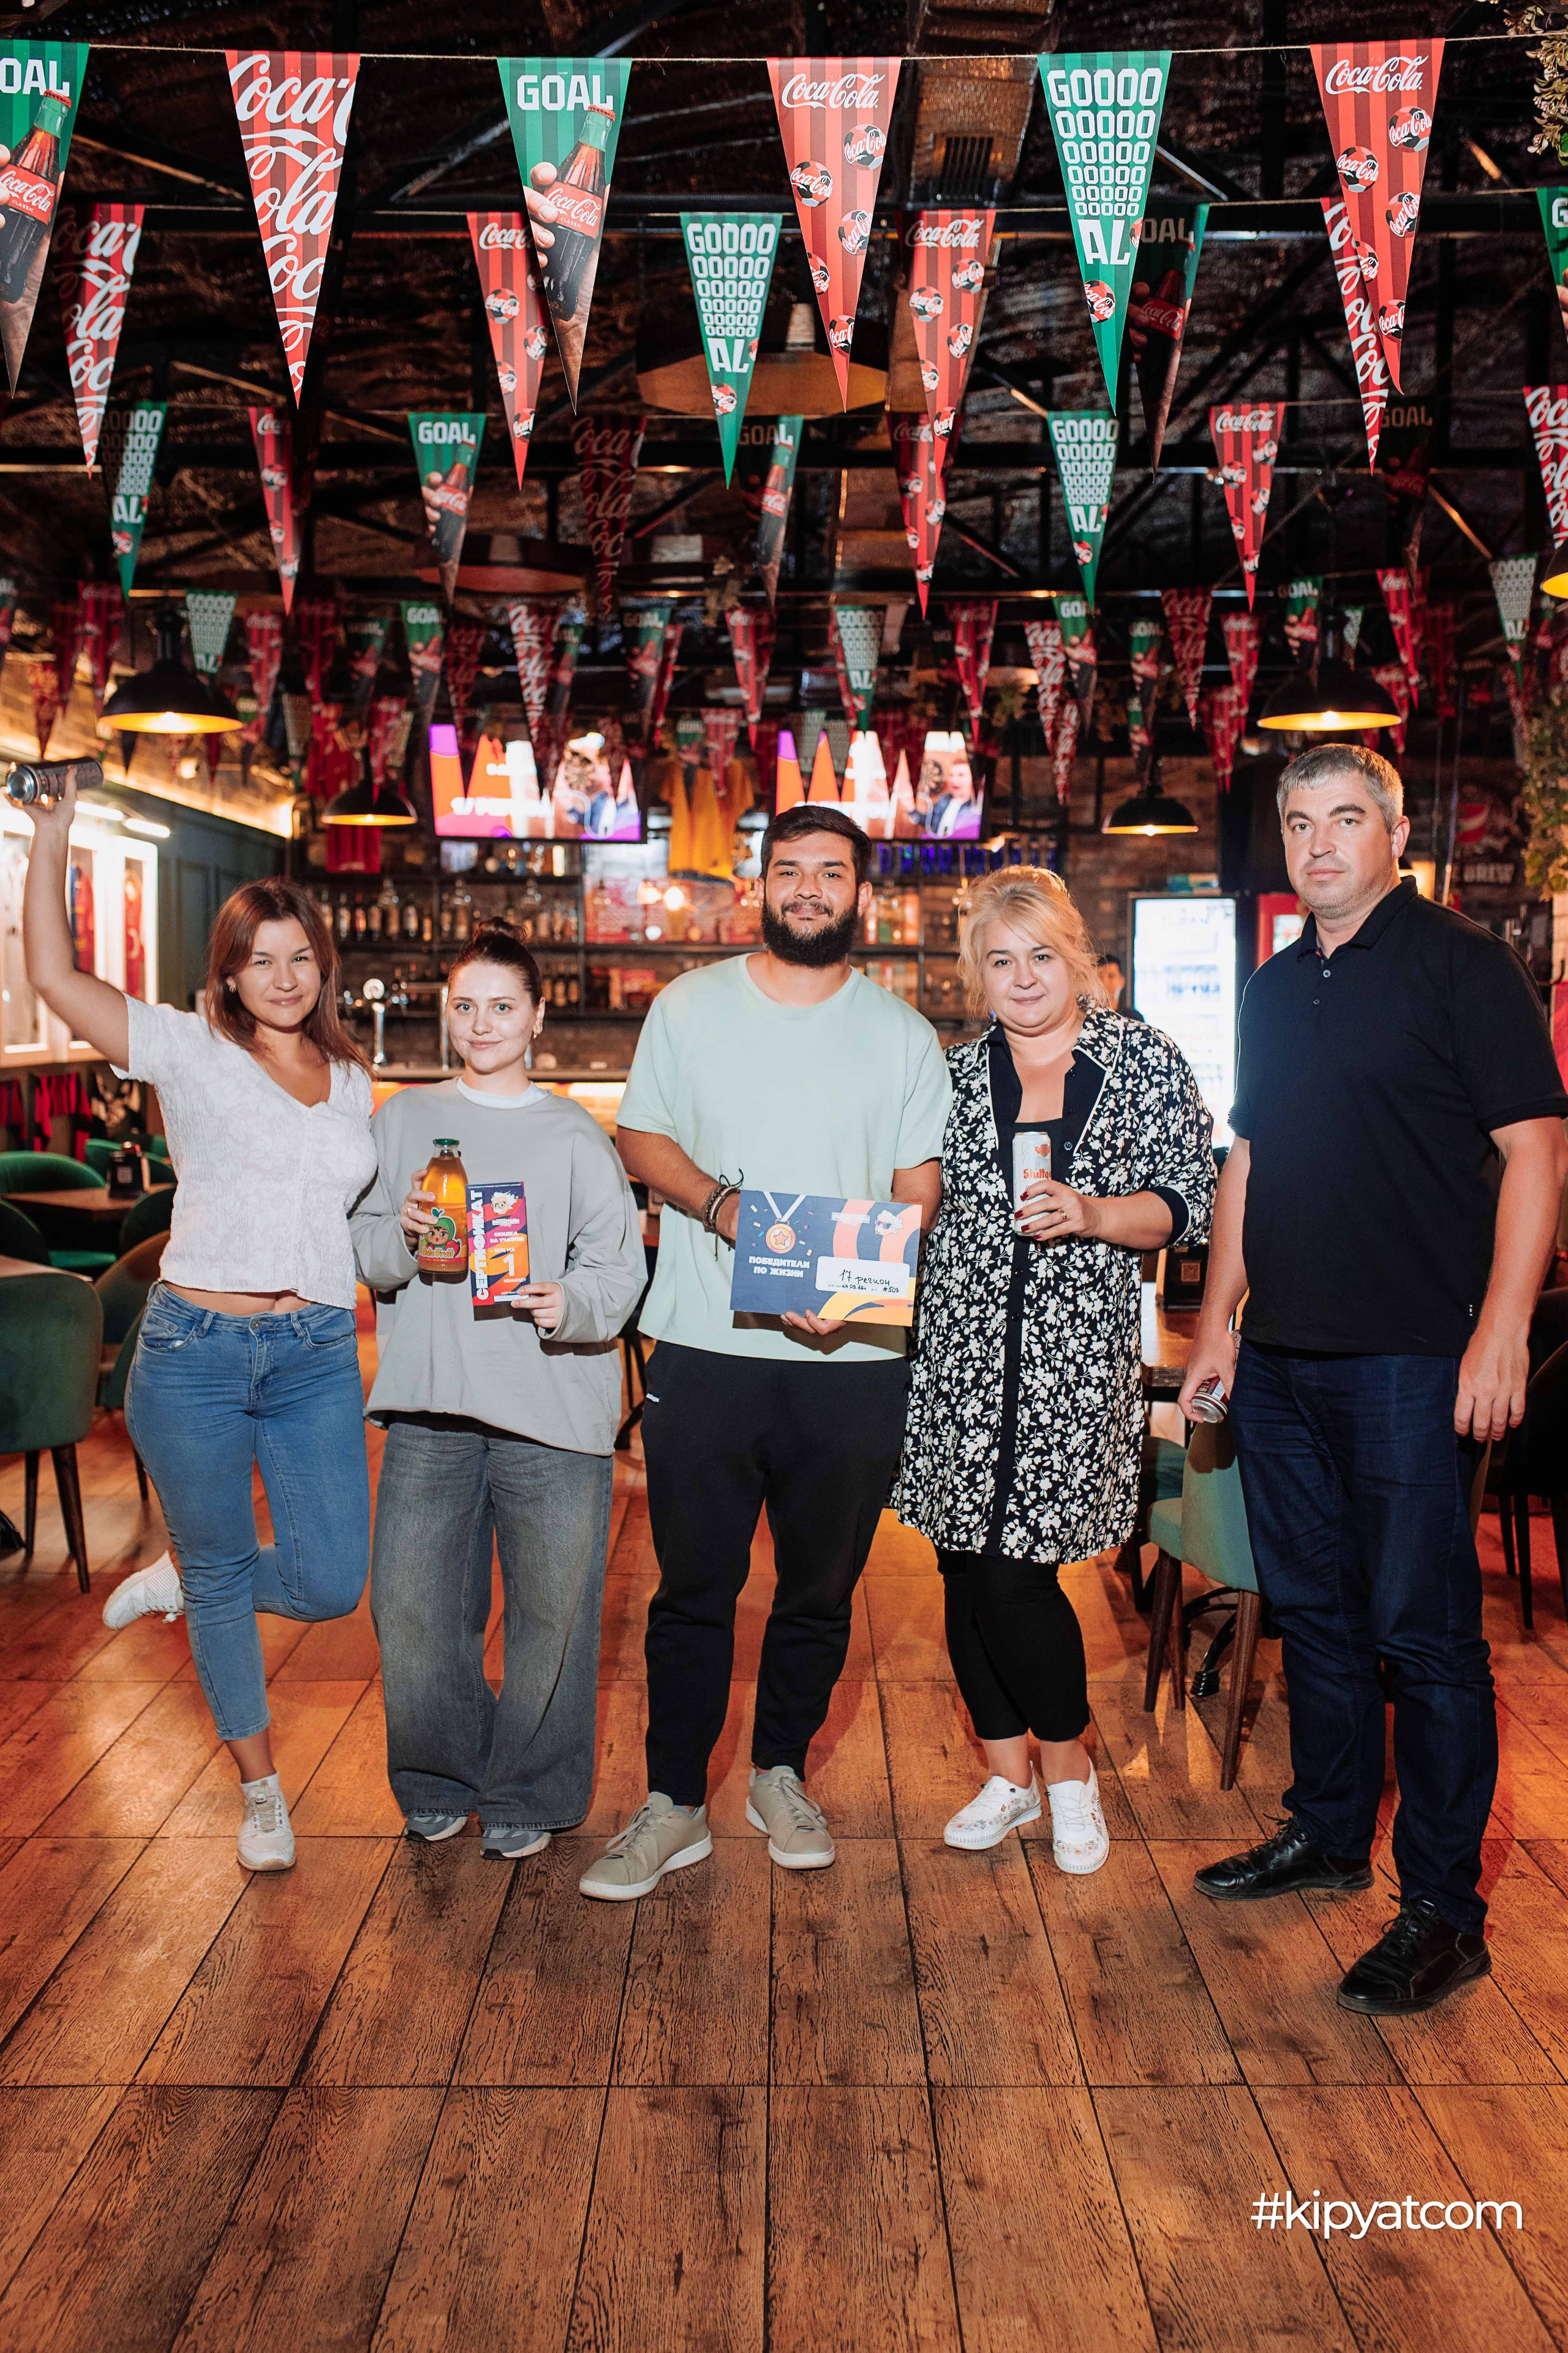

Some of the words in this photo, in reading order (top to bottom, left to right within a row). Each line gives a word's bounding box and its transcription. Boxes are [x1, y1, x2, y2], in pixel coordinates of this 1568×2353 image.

[1047, 67, 1163, 107] GOOOO
[1325, 55, 1429, 95] Coca-Cola
[517, 75, 614, 111] GOAL
[782, 73, 886, 109] Coca-Cola
[1055, 110, 1156, 139] OOOOO
[1061, 141, 1151, 164] OOOOO
[1067, 165, 1147, 185] OOOOO
[1071, 185, 1143, 202] OOOOO
[12, 199, 34, 213] CLASSIC
[546, 188, 602, 227] Coca-Cola
[1074, 202, 1140, 216] OOOOO
[560, 217, 582, 229] CLASSIC
[905, 219, 984, 248] Coca-Cola
[687, 223, 776, 254] GOOOO
[1077, 219, 1131, 265] AL
[692, 255, 771, 279] OOOOO
[696, 279, 766, 298] OOOOO
[699, 298, 762, 314] OOOOO
[703, 313, 759, 327] OOOOO
[705, 326, 756, 337] OOOOO
[707, 338, 749, 373] AL
[418, 421, 477, 445] GOAL
[1052, 418, 1120, 443] GOOOO
[1216, 410, 1276, 433] Coca-Cola
[1056, 443, 1117, 461] OOOOO
[1069, 505, 1102, 533] AL
[470, 1190, 489, 1300] СЕРТИФИКАТ
[503, 1253, 515, 1277] 1
[748, 1256, 810, 1269] ПОБЕДИТЕЛИ
[753, 1266, 767, 1275] ПО
[769, 1267, 804, 1278] ЖИЗНИ
[839, 1269, 852, 1282] 17
[855, 1275, 890, 1286] регион
